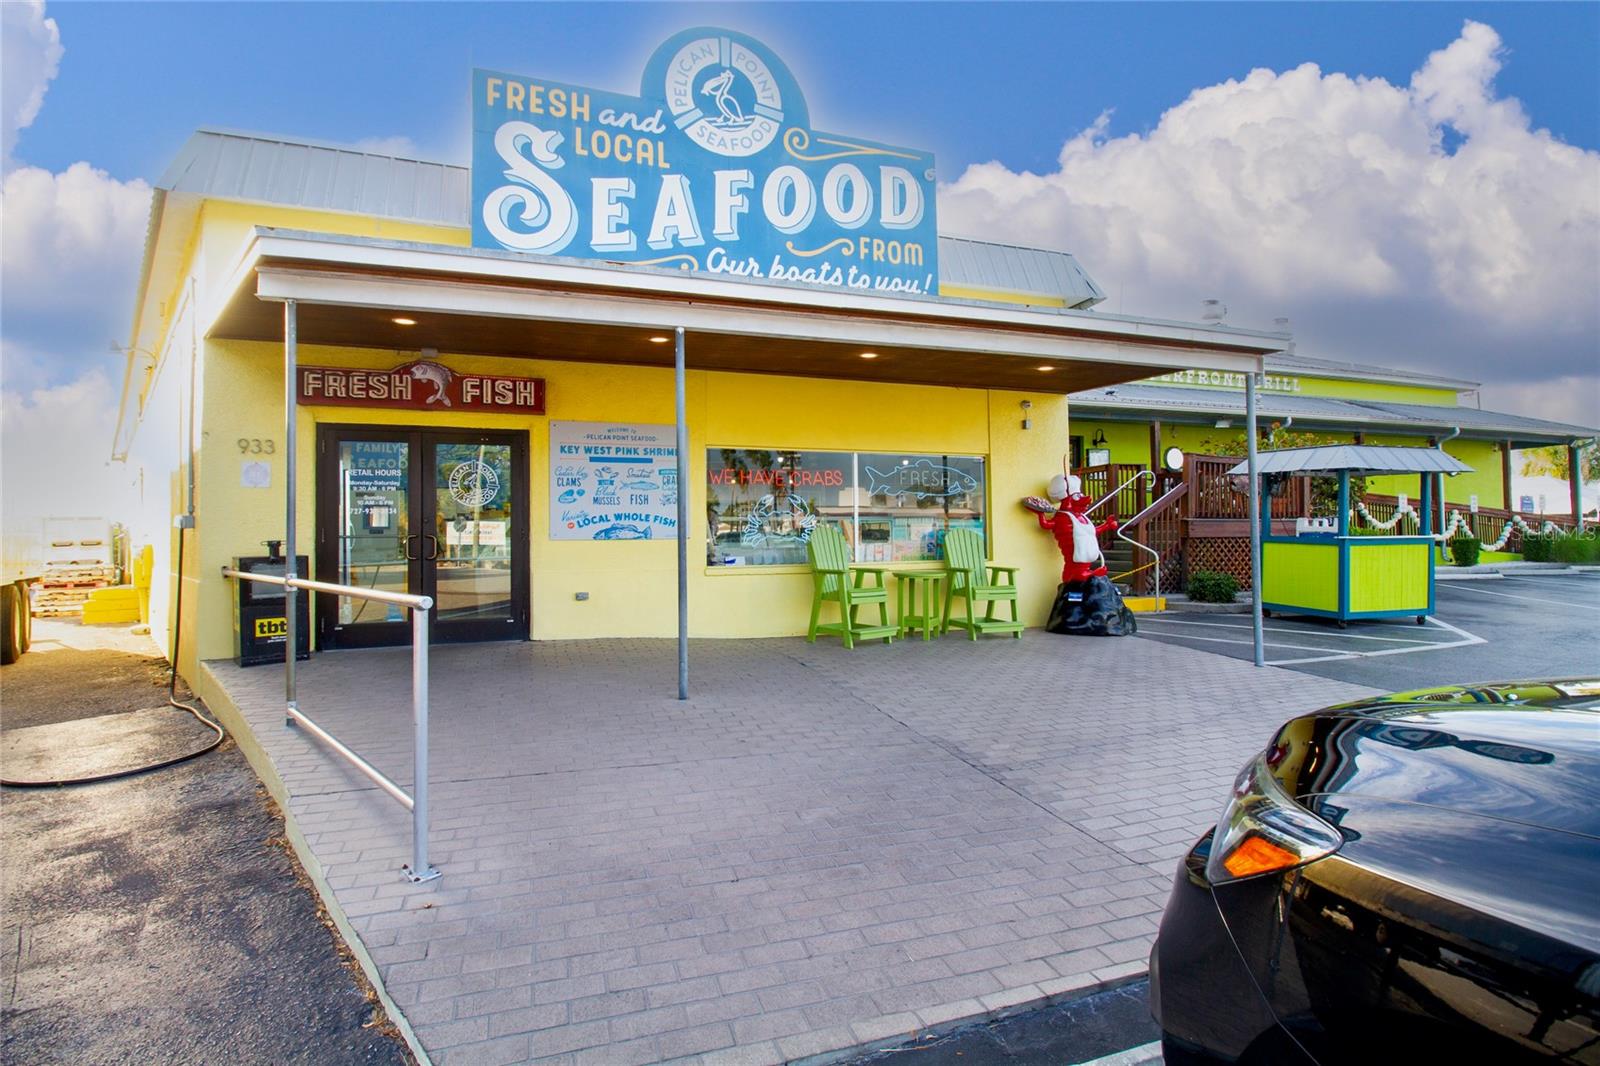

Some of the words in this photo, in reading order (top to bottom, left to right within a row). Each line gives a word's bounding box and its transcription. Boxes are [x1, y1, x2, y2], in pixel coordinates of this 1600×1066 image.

[674, 43, 714, 107] PELICAN
[736, 52, 775, 102] POINT
[487, 77, 590, 122] FRESH
[598, 108, 667, 134] and
[696, 120, 773, 150] SEAFOOD
[575, 127, 670, 169] LOCAL
[482, 120, 925, 255] SEAFOOD
[859, 236, 923, 267] FROM
[706, 247, 764, 278] Our
[768, 255, 844, 288] boats
[847, 265, 871, 290] to
[875, 273, 933, 295] you!
[303, 371, 413, 401] FRESH
[462, 378, 536, 407] FISH
[1255, 376, 1300, 391] RILL
[237, 438, 276, 455] 933
[356, 443, 399, 453] FAMILY
[560, 445, 580, 454] KEY
[584, 446, 612, 455] WEST
[615, 447, 640, 456] PINK
[375, 469, 402, 477] HOURS
[557, 477, 582, 487] CLAMS
[662, 476, 677, 485] CRA
[709, 468, 736, 486] WE
[739, 469, 785, 487] HAVE
[790, 469, 844, 487] CRABS
[900, 470, 950, 488] FRESH
[593, 496, 621, 506] MUSSELS
[630, 494, 649, 505] FISH
[577, 514, 611, 528] LOCAL
[614, 512, 651, 522] WHOLE
[653, 514, 677, 528] FISH
